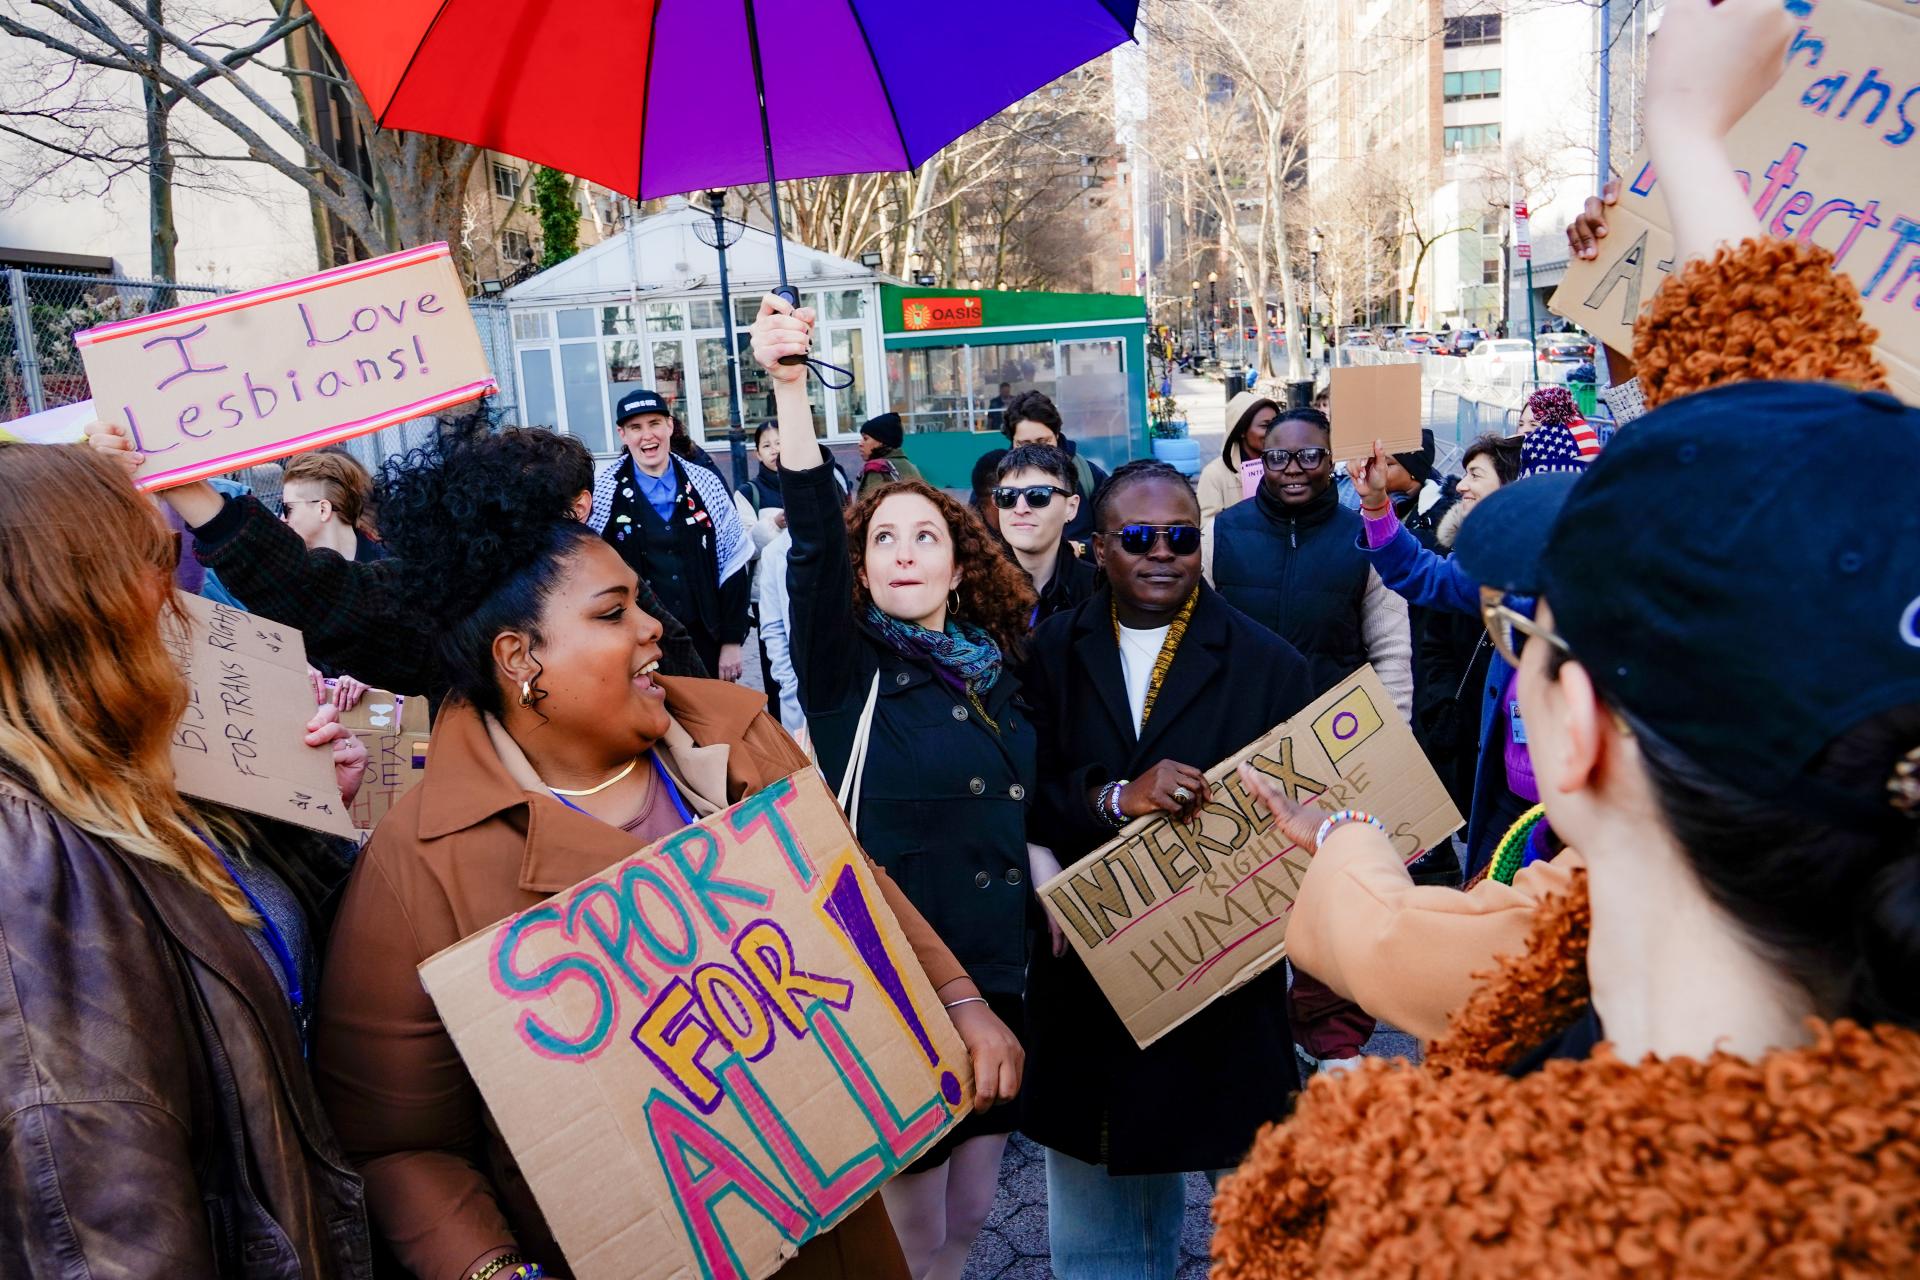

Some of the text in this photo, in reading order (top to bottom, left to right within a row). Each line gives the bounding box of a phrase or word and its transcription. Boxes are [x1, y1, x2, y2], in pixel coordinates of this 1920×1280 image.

[1630, 142, 1881, 270] tect
[142, 289, 445, 392] I Love
[932, 307, 982, 321] OASIS
[123, 334, 430, 456] Lesbians!
[220, 660, 255, 717] TRANS
[225, 722, 270, 780] FOR
[1048, 736, 1328, 950] INTERSEX
[1200, 762, 1371, 898] RIGHT ARE
[489, 775, 818, 1063] SPORT
[630, 918, 854, 1115] FOR
